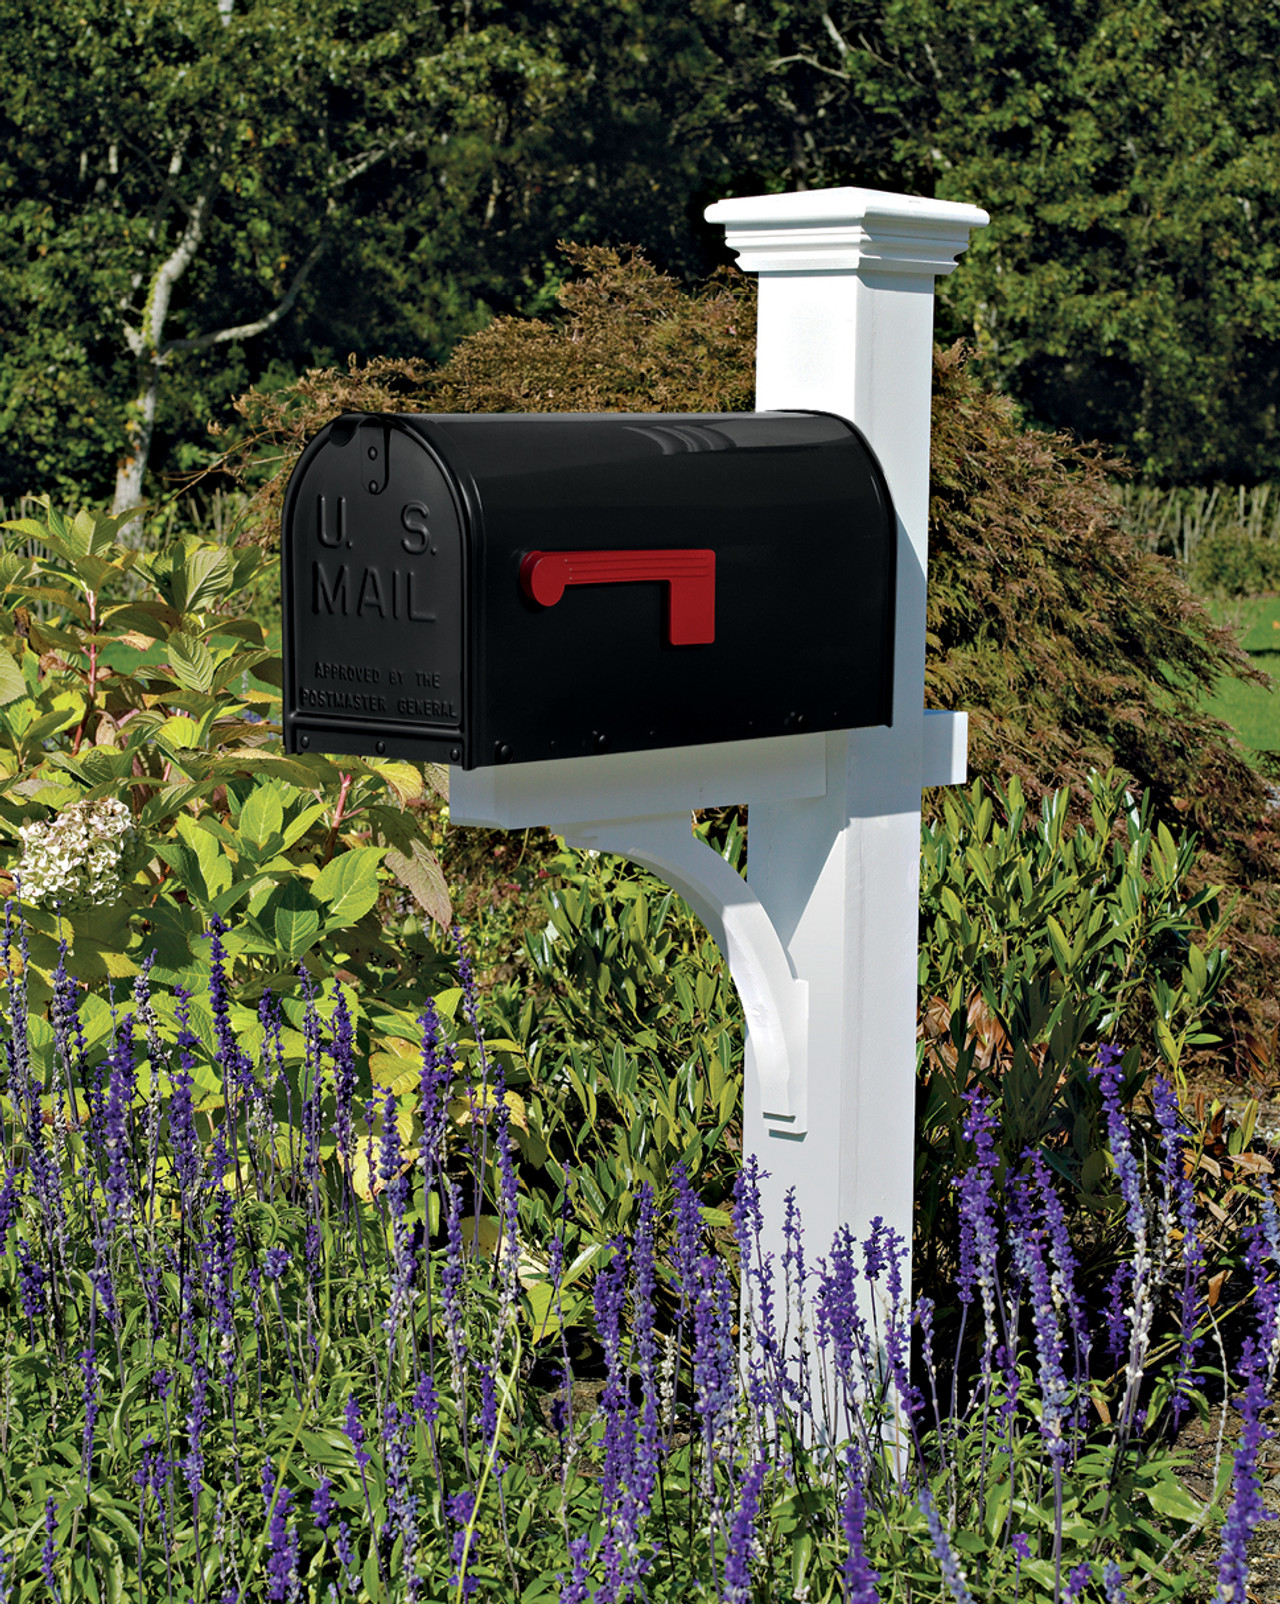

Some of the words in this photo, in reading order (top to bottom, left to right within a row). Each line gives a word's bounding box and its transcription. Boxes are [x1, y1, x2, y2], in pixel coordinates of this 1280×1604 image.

[318, 494, 353, 549] U.
[401, 499, 437, 556] S.
[312, 561, 436, 623] MAIL
[314, 662, 380, 684] APPROVED
[389, 669, 404, 685] BY
[415, 670, 441, 689] THE
[299, 686, 386, 712] POSTMASTER
[397, 698, 458, 718] GENERAL
